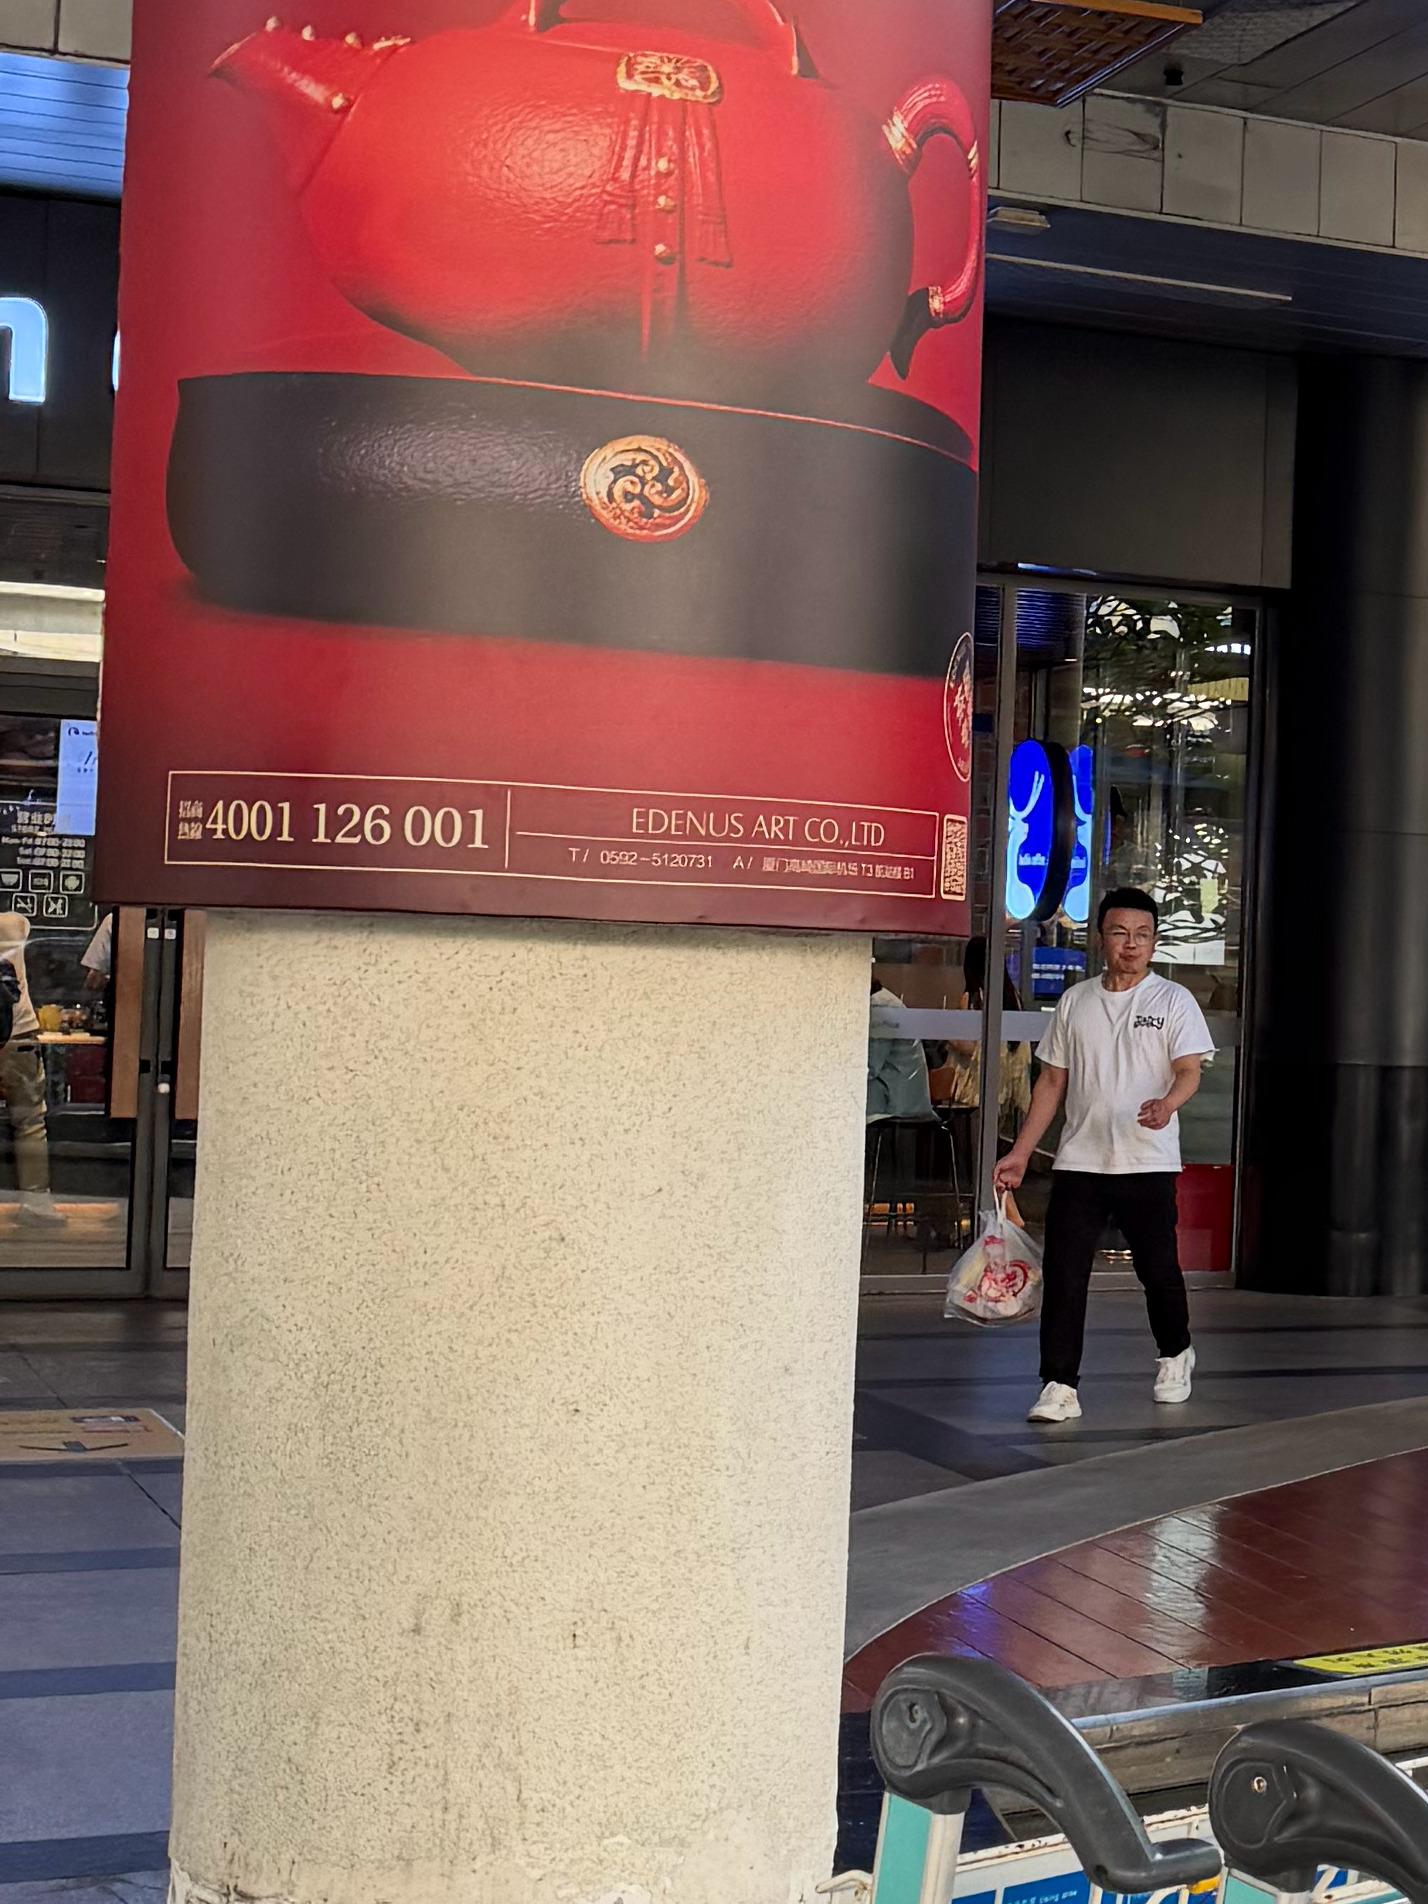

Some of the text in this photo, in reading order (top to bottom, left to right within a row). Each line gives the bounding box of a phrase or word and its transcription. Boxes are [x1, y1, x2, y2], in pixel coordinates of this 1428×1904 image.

[204, 799, 294, 842] 4001
[311, 802, 392, 846] 126
[403, 805, 490, 849] 001
[631, 807, 886, 849] EDENUS ART CO.,LTD
[599, 848, 714, 870] 0592-5120731
